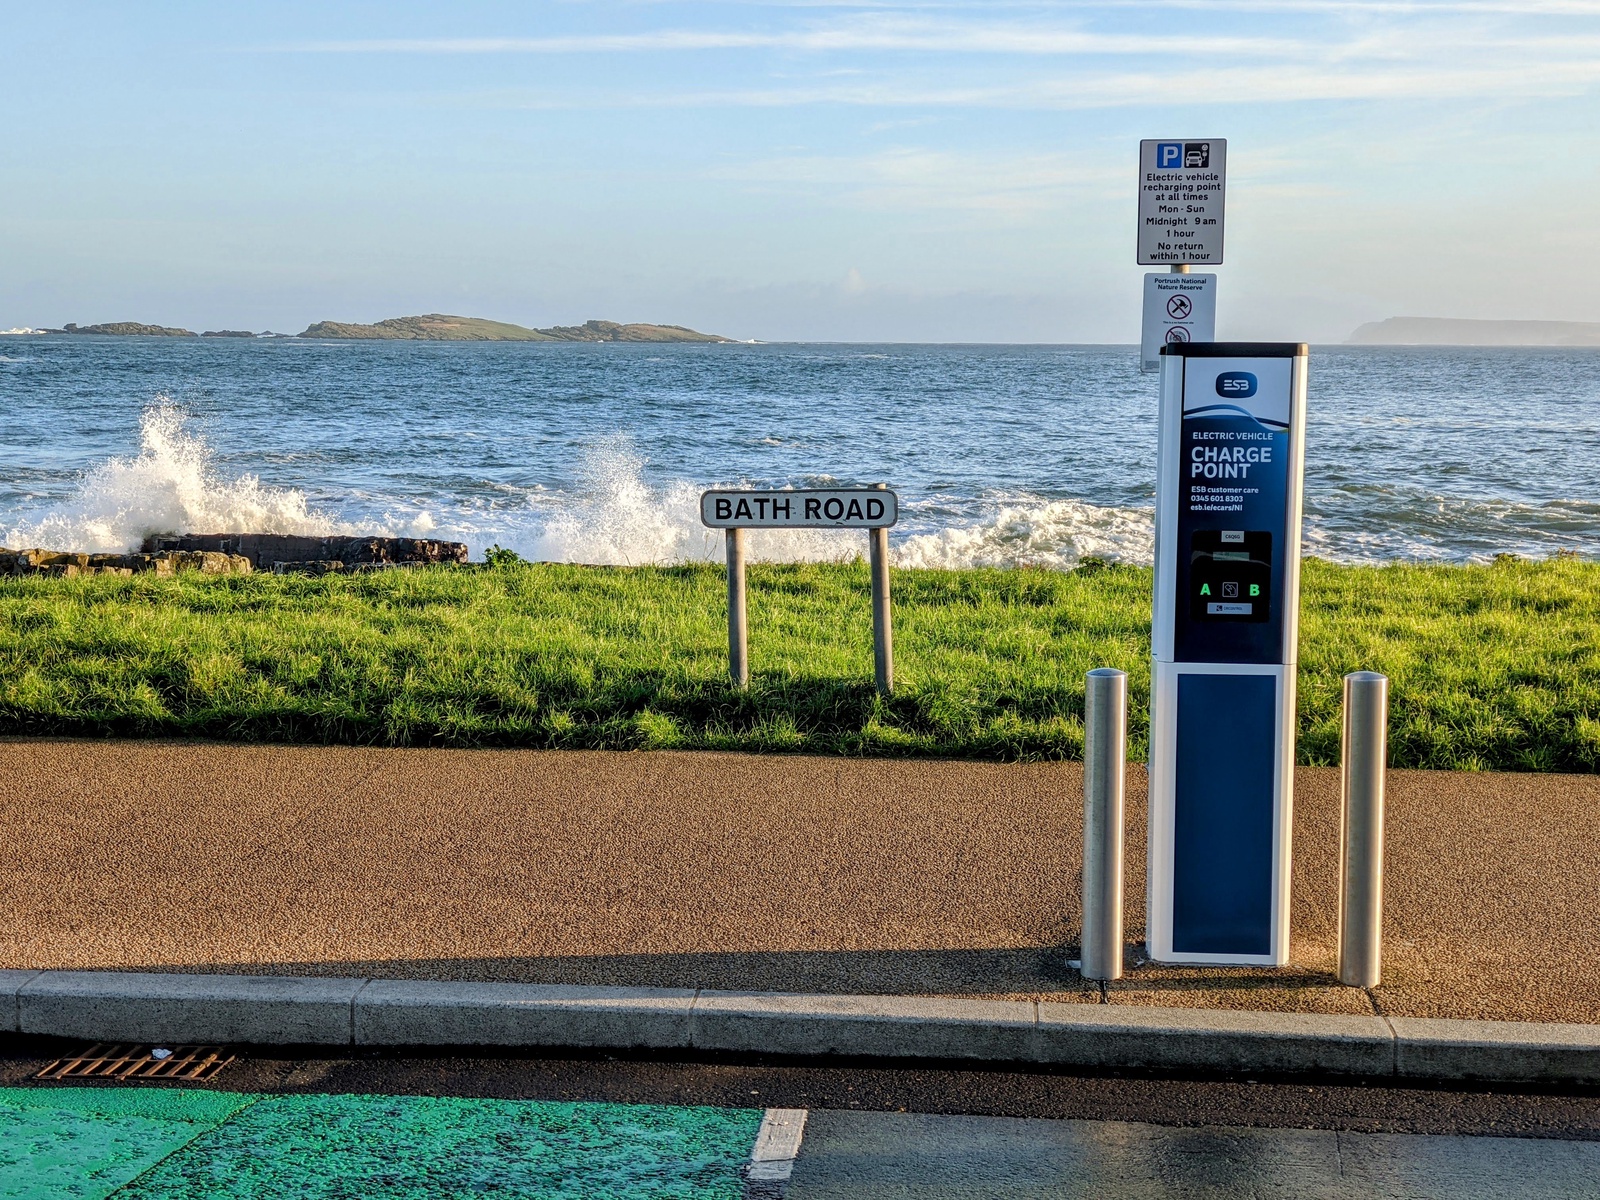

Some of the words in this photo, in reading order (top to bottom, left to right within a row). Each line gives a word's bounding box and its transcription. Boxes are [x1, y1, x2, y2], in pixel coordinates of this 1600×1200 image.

[1163, 146, 1178, 166] P
[1144, 183, 1194, 192] recharging
[1197, 183, 1221, 192] point
[1146, 218, 1188, 226] Midnight
[1174, 230, 1195, 238] hour
[1150, 252, 1178, 260] within
[1189, 252, 1210, 260] hour
[1224, 379, 1249, 390] ESB
[1192, 432, 1234, 440] ELECTRIC
[1236, 432, 1274, 440] VEHICLE
[1192, 446, 1272, 462] CHARGE
[1192, 463, 1251, 478] POINT
[715, 498, 790, 520] BATH
[804, 498, 885, 520] ROAD
[1200, 584, 1211, 596] A
[1250, 584, 1260, 596] B
